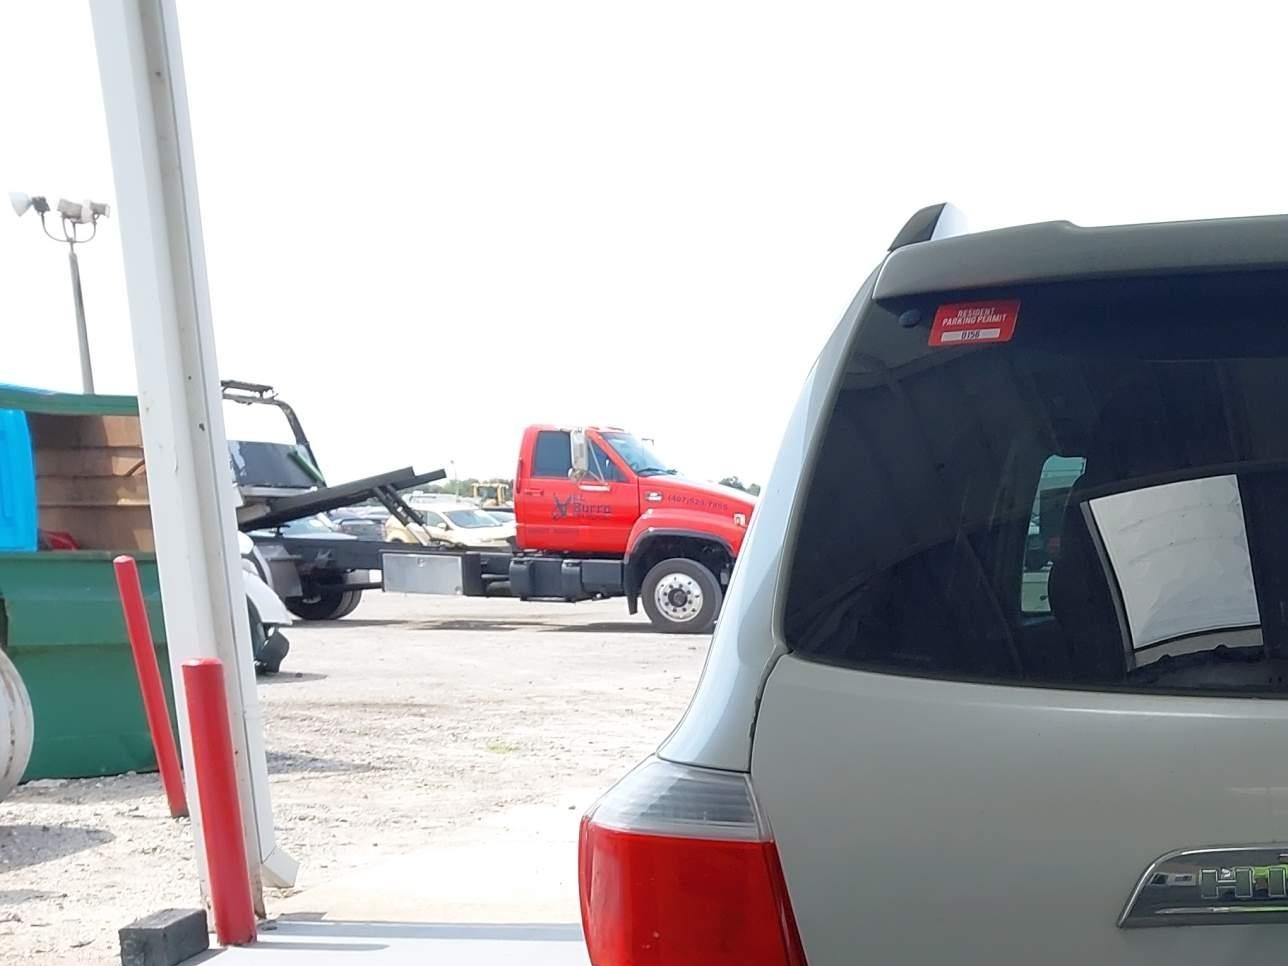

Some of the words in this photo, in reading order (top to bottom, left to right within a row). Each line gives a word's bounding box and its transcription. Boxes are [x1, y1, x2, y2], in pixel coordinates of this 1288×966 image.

[957, 307, 995, 318] RESIDENT
[942, 316, 976, 326] PARKING
[977, 313, 1007, 323] PERMIT
